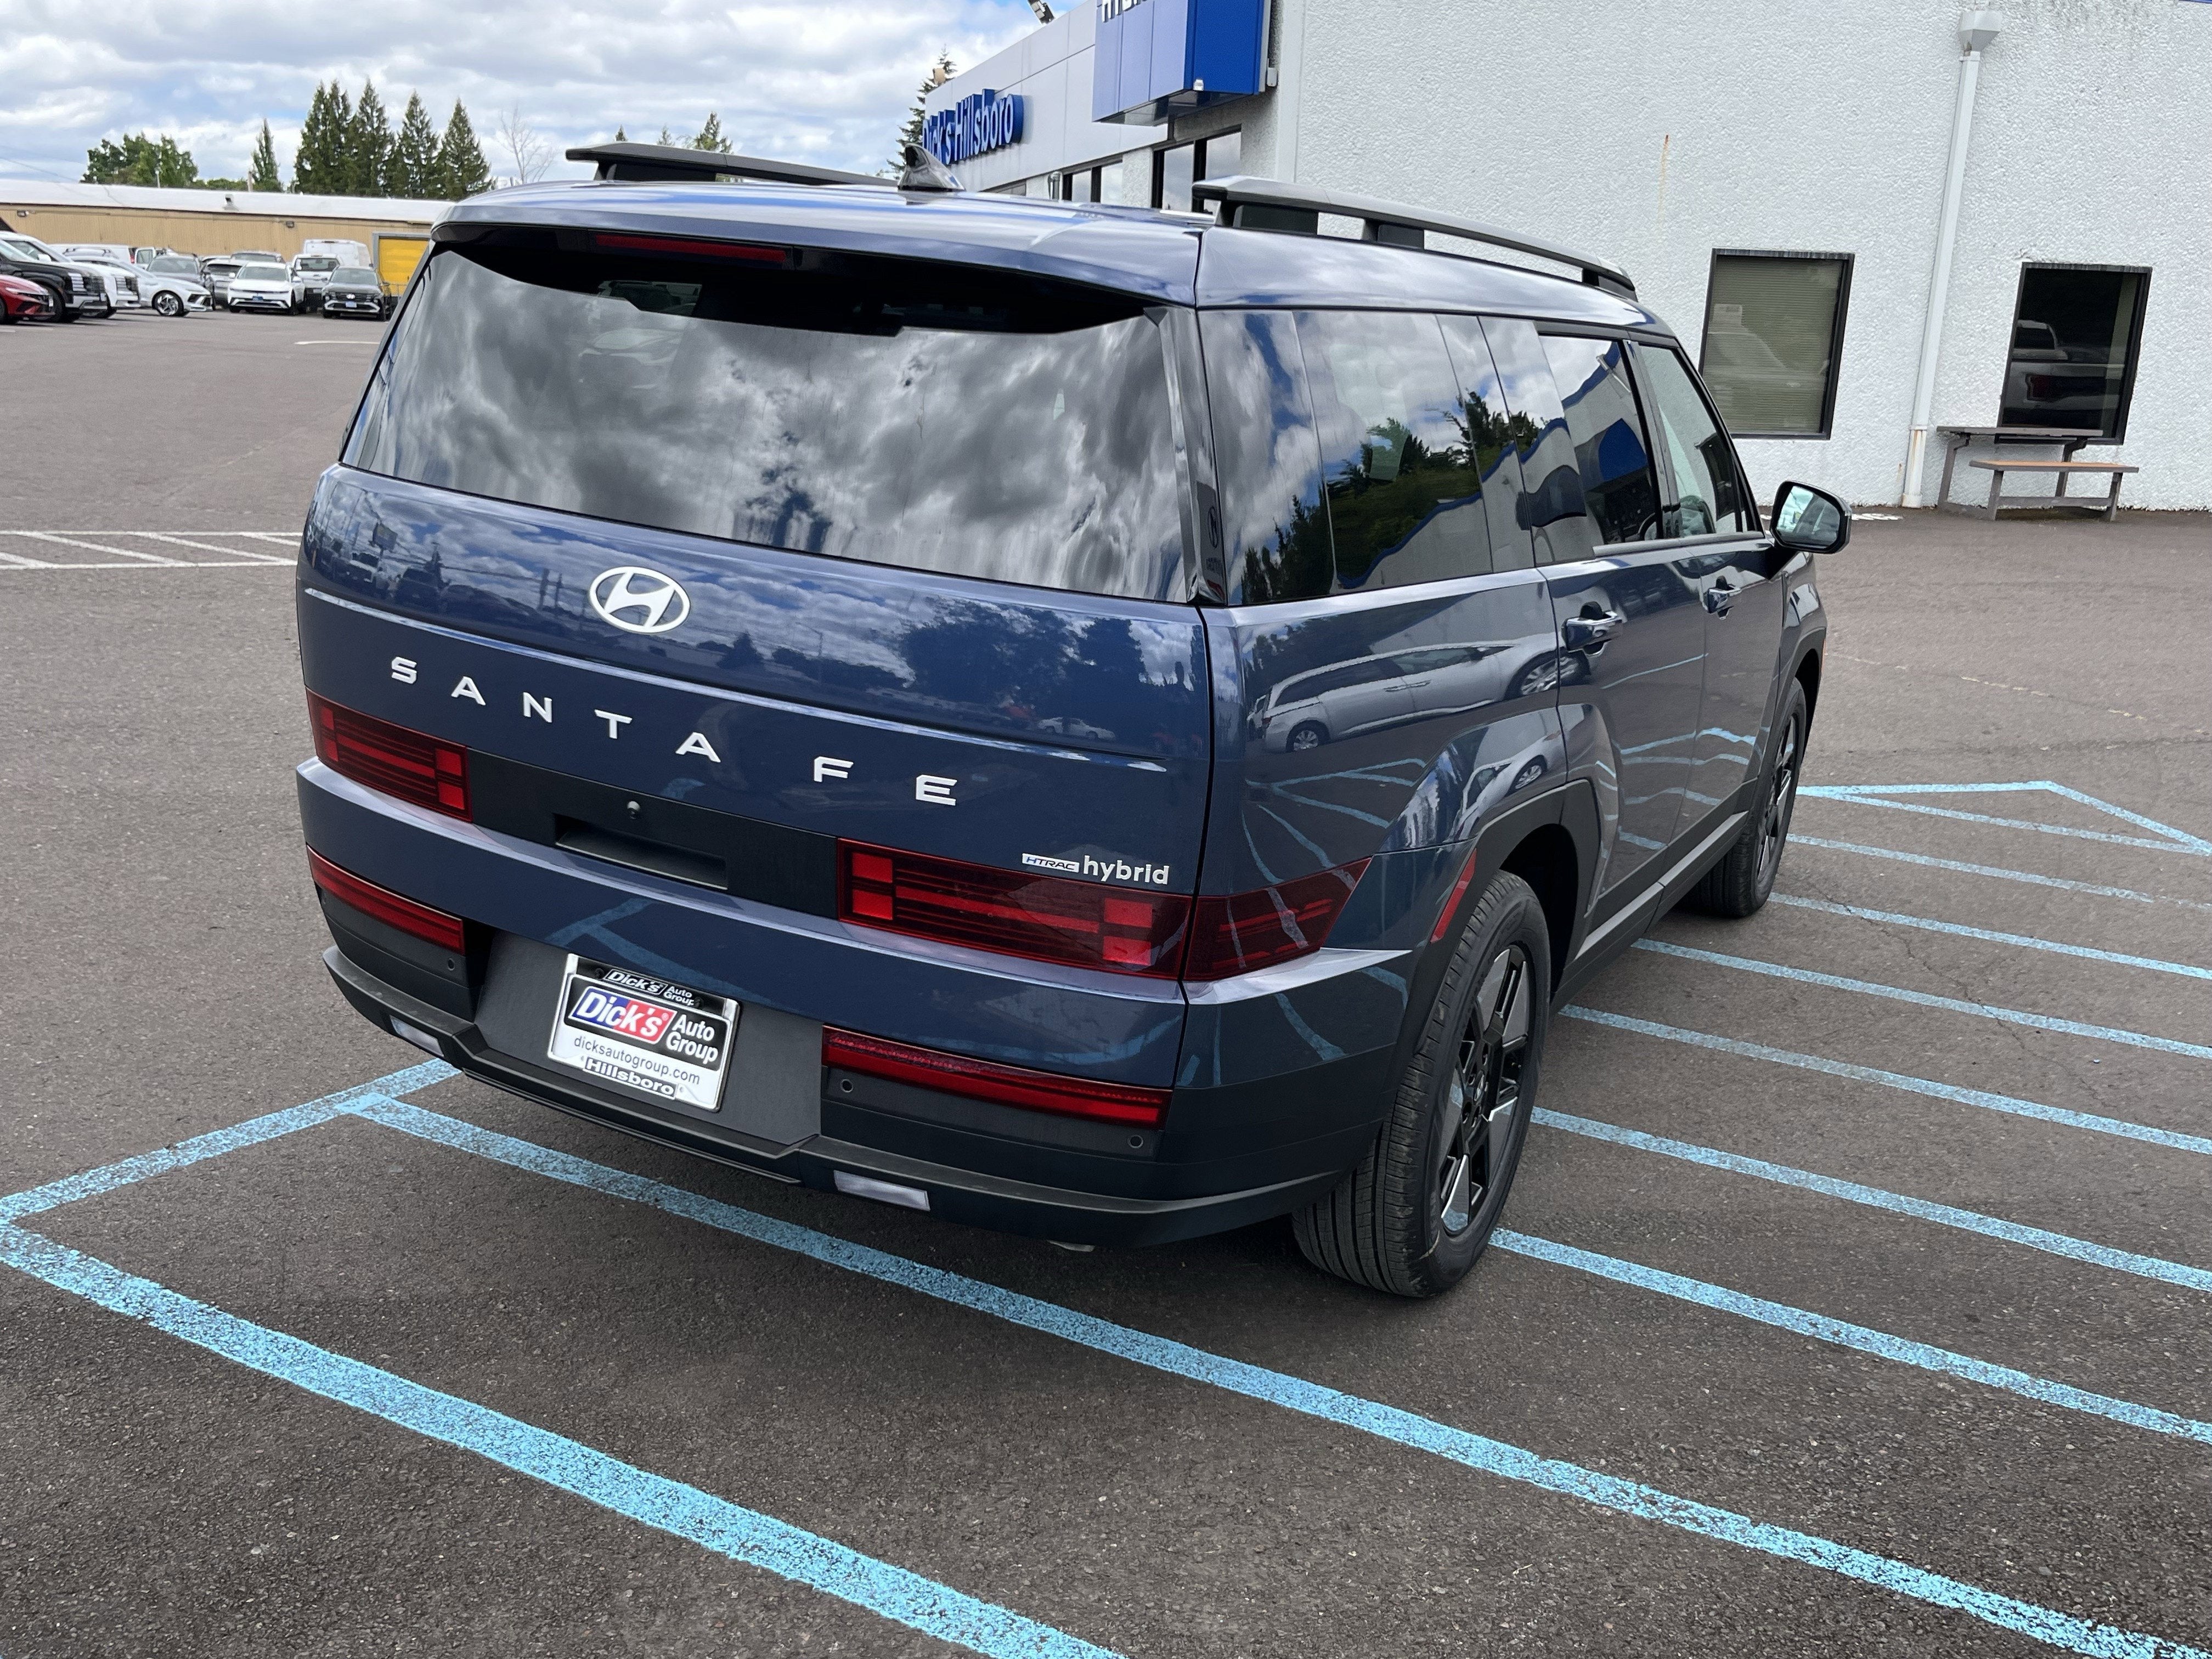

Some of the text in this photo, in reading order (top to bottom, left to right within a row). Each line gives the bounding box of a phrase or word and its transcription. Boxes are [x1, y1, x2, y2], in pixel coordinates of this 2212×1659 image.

[955, 89, 1016, 161] Hillsboro
[391, 657, 957, 806] SANTA FE
[1026, 855, 1170, 884] HTRAC hybrid
[608, 972, 661, 992] Dick's
[667, 986, 692, 998] Auto
[575, 991, 663, 1037] Dick's
[672, 1014, 715, 1042] Auto
[574, 1036, 701, 1085] dicksautogroup.com
[666, 1032, 719, 1064] Group
[586, 1057, 675, 1096] Hillsboro
